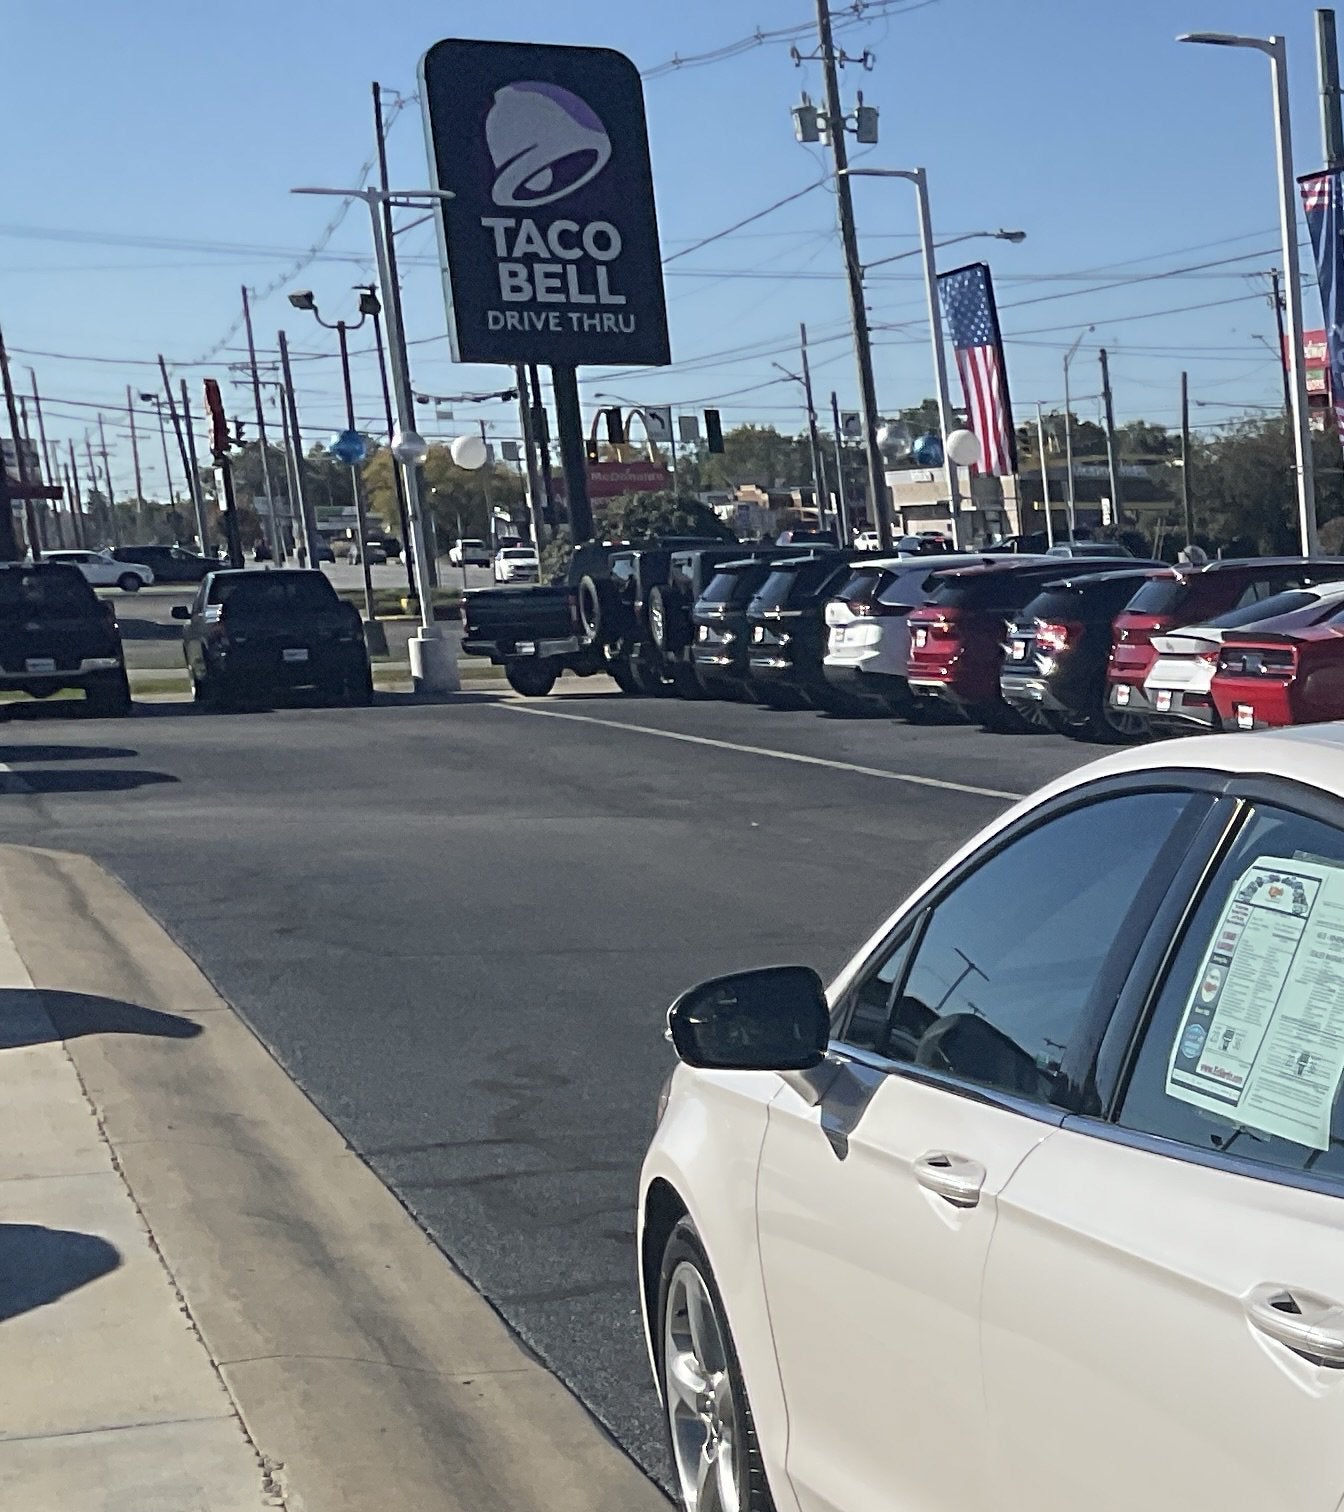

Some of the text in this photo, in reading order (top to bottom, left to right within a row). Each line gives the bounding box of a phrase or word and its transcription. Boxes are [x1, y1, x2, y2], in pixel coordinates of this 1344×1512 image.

[481, 216, 622, 261] TACO
[498, 262, 627, 304] BELL
[487, 310, 636, 333] DRIVE THRU
